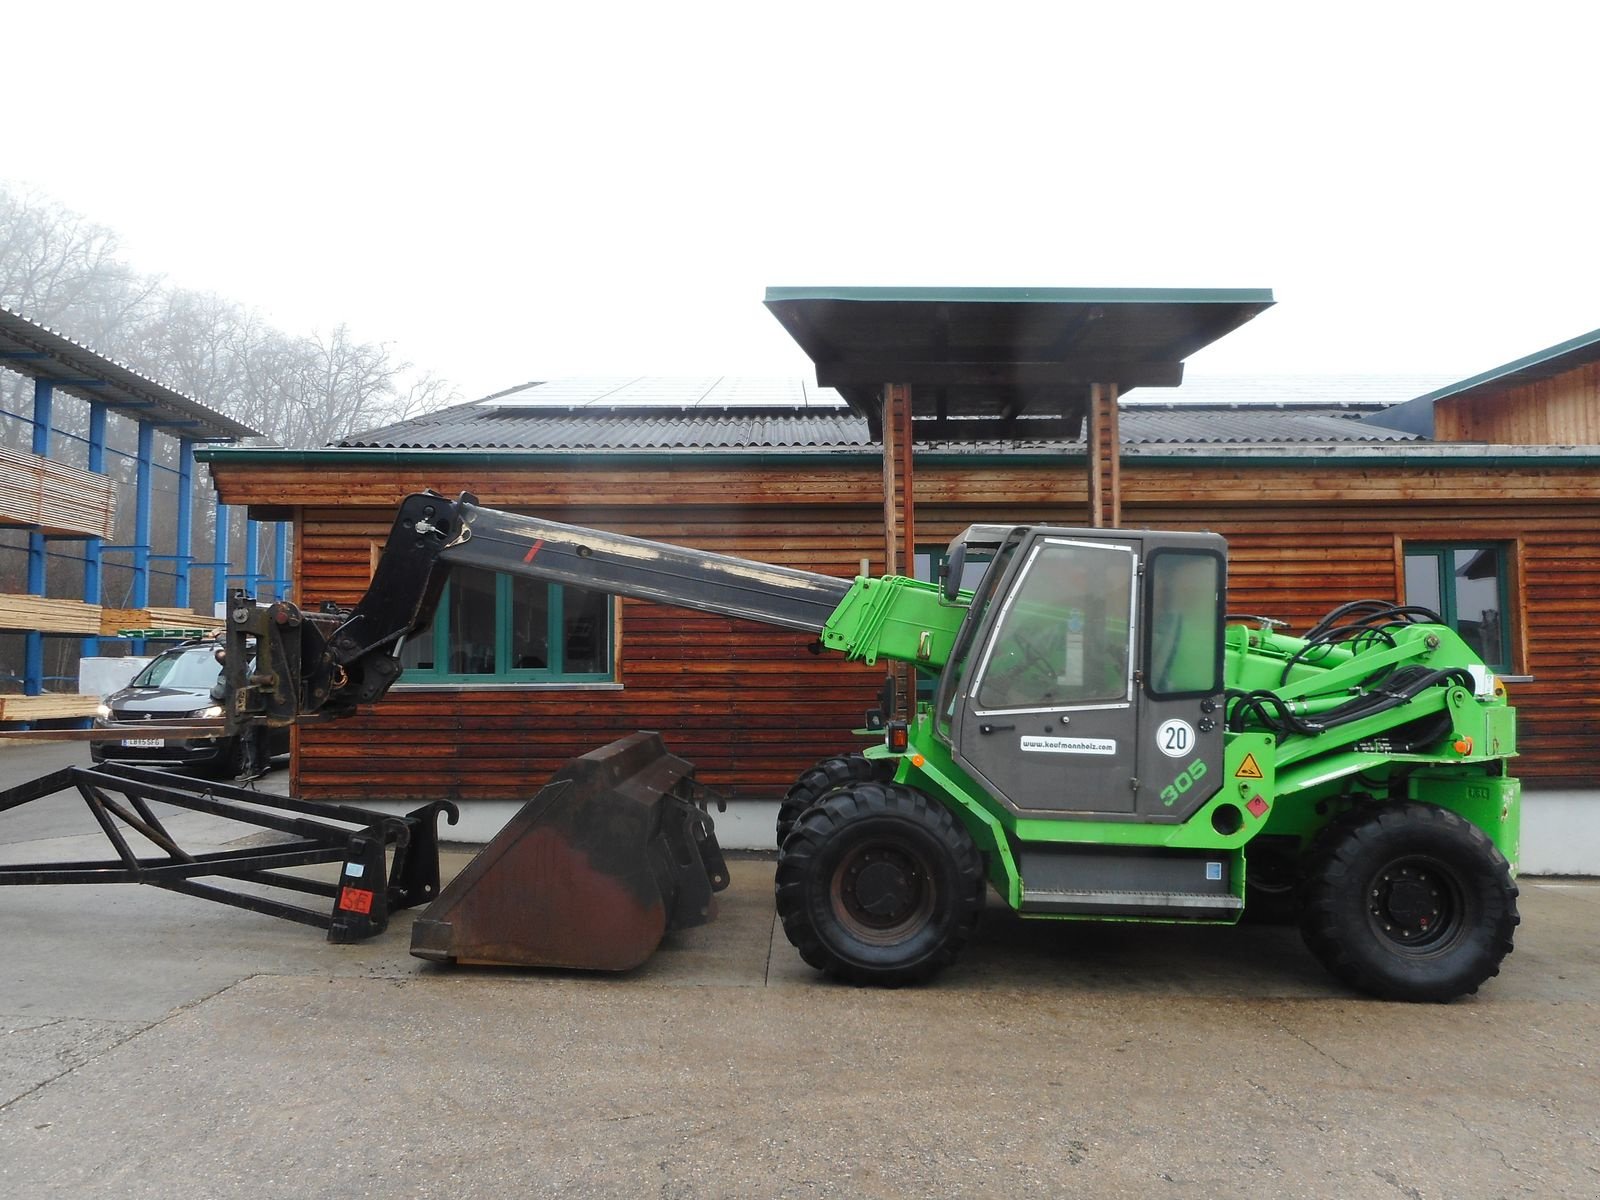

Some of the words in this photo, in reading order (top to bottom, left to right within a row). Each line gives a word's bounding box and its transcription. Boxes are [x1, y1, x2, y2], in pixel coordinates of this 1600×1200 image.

[1022, 740, 1113, 751] www.kaufmannholz.com
[1166, 727, 1187, 750] 20
[1160, 758, 1208, 807] 305
